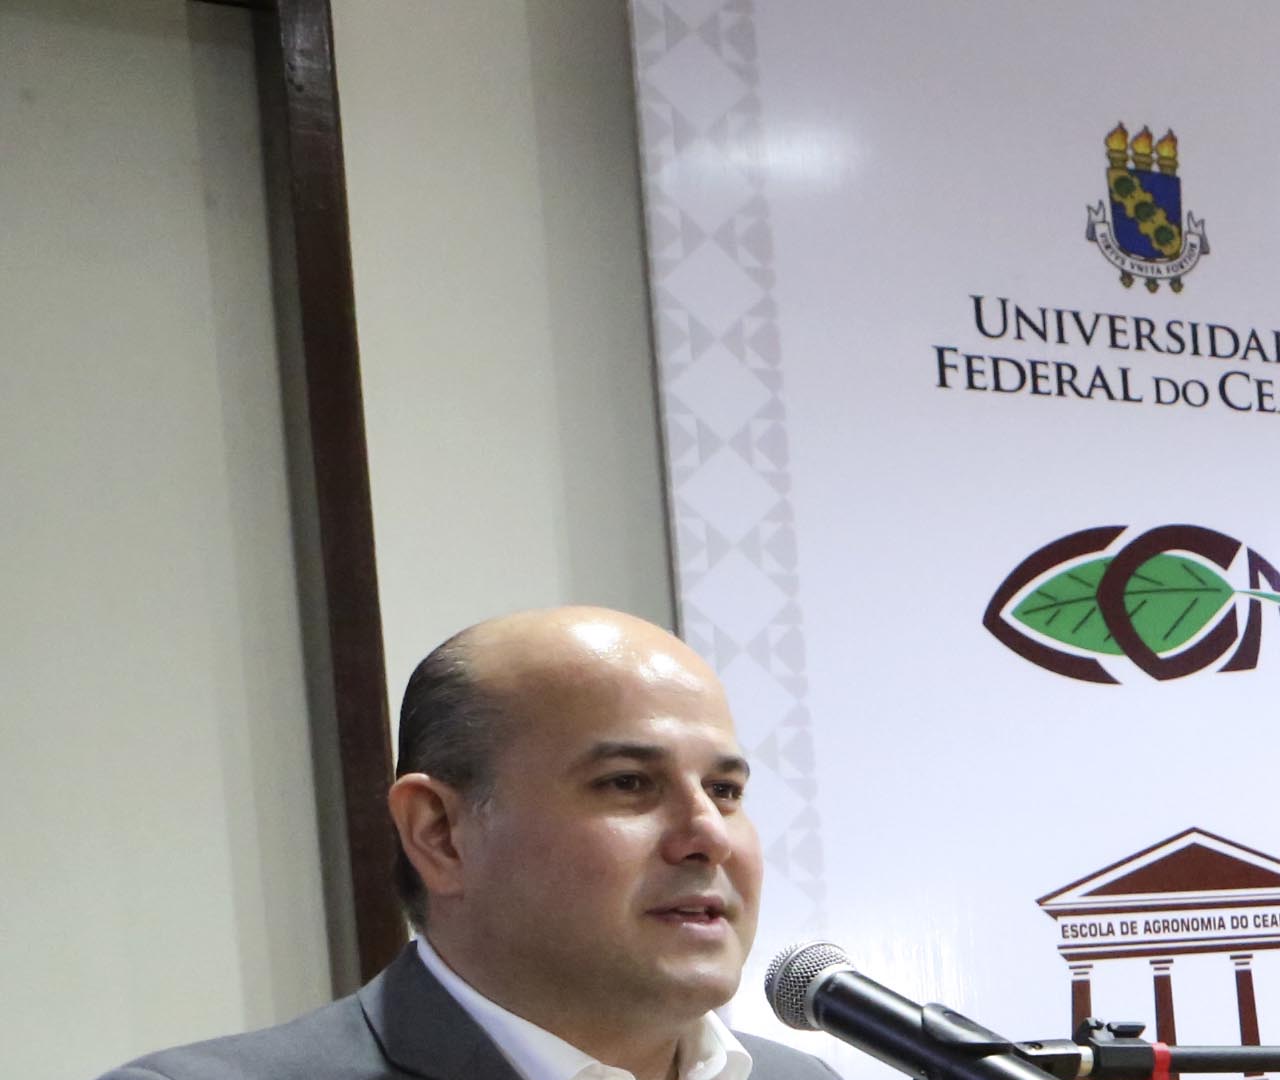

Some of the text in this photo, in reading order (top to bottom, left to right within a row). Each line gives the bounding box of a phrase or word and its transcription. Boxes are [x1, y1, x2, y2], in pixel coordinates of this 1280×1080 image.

[931, 344, 1144, 404] FEDERAL
[1153, 376, 1209, 410] DO
[1061, 921, 1115, 940] ESCOLA
[1120, 918, 1138, 936] DE
[1143, 916, 1226, 935] AGRONOMIA
[1231, 913, 1249, 930] DO
